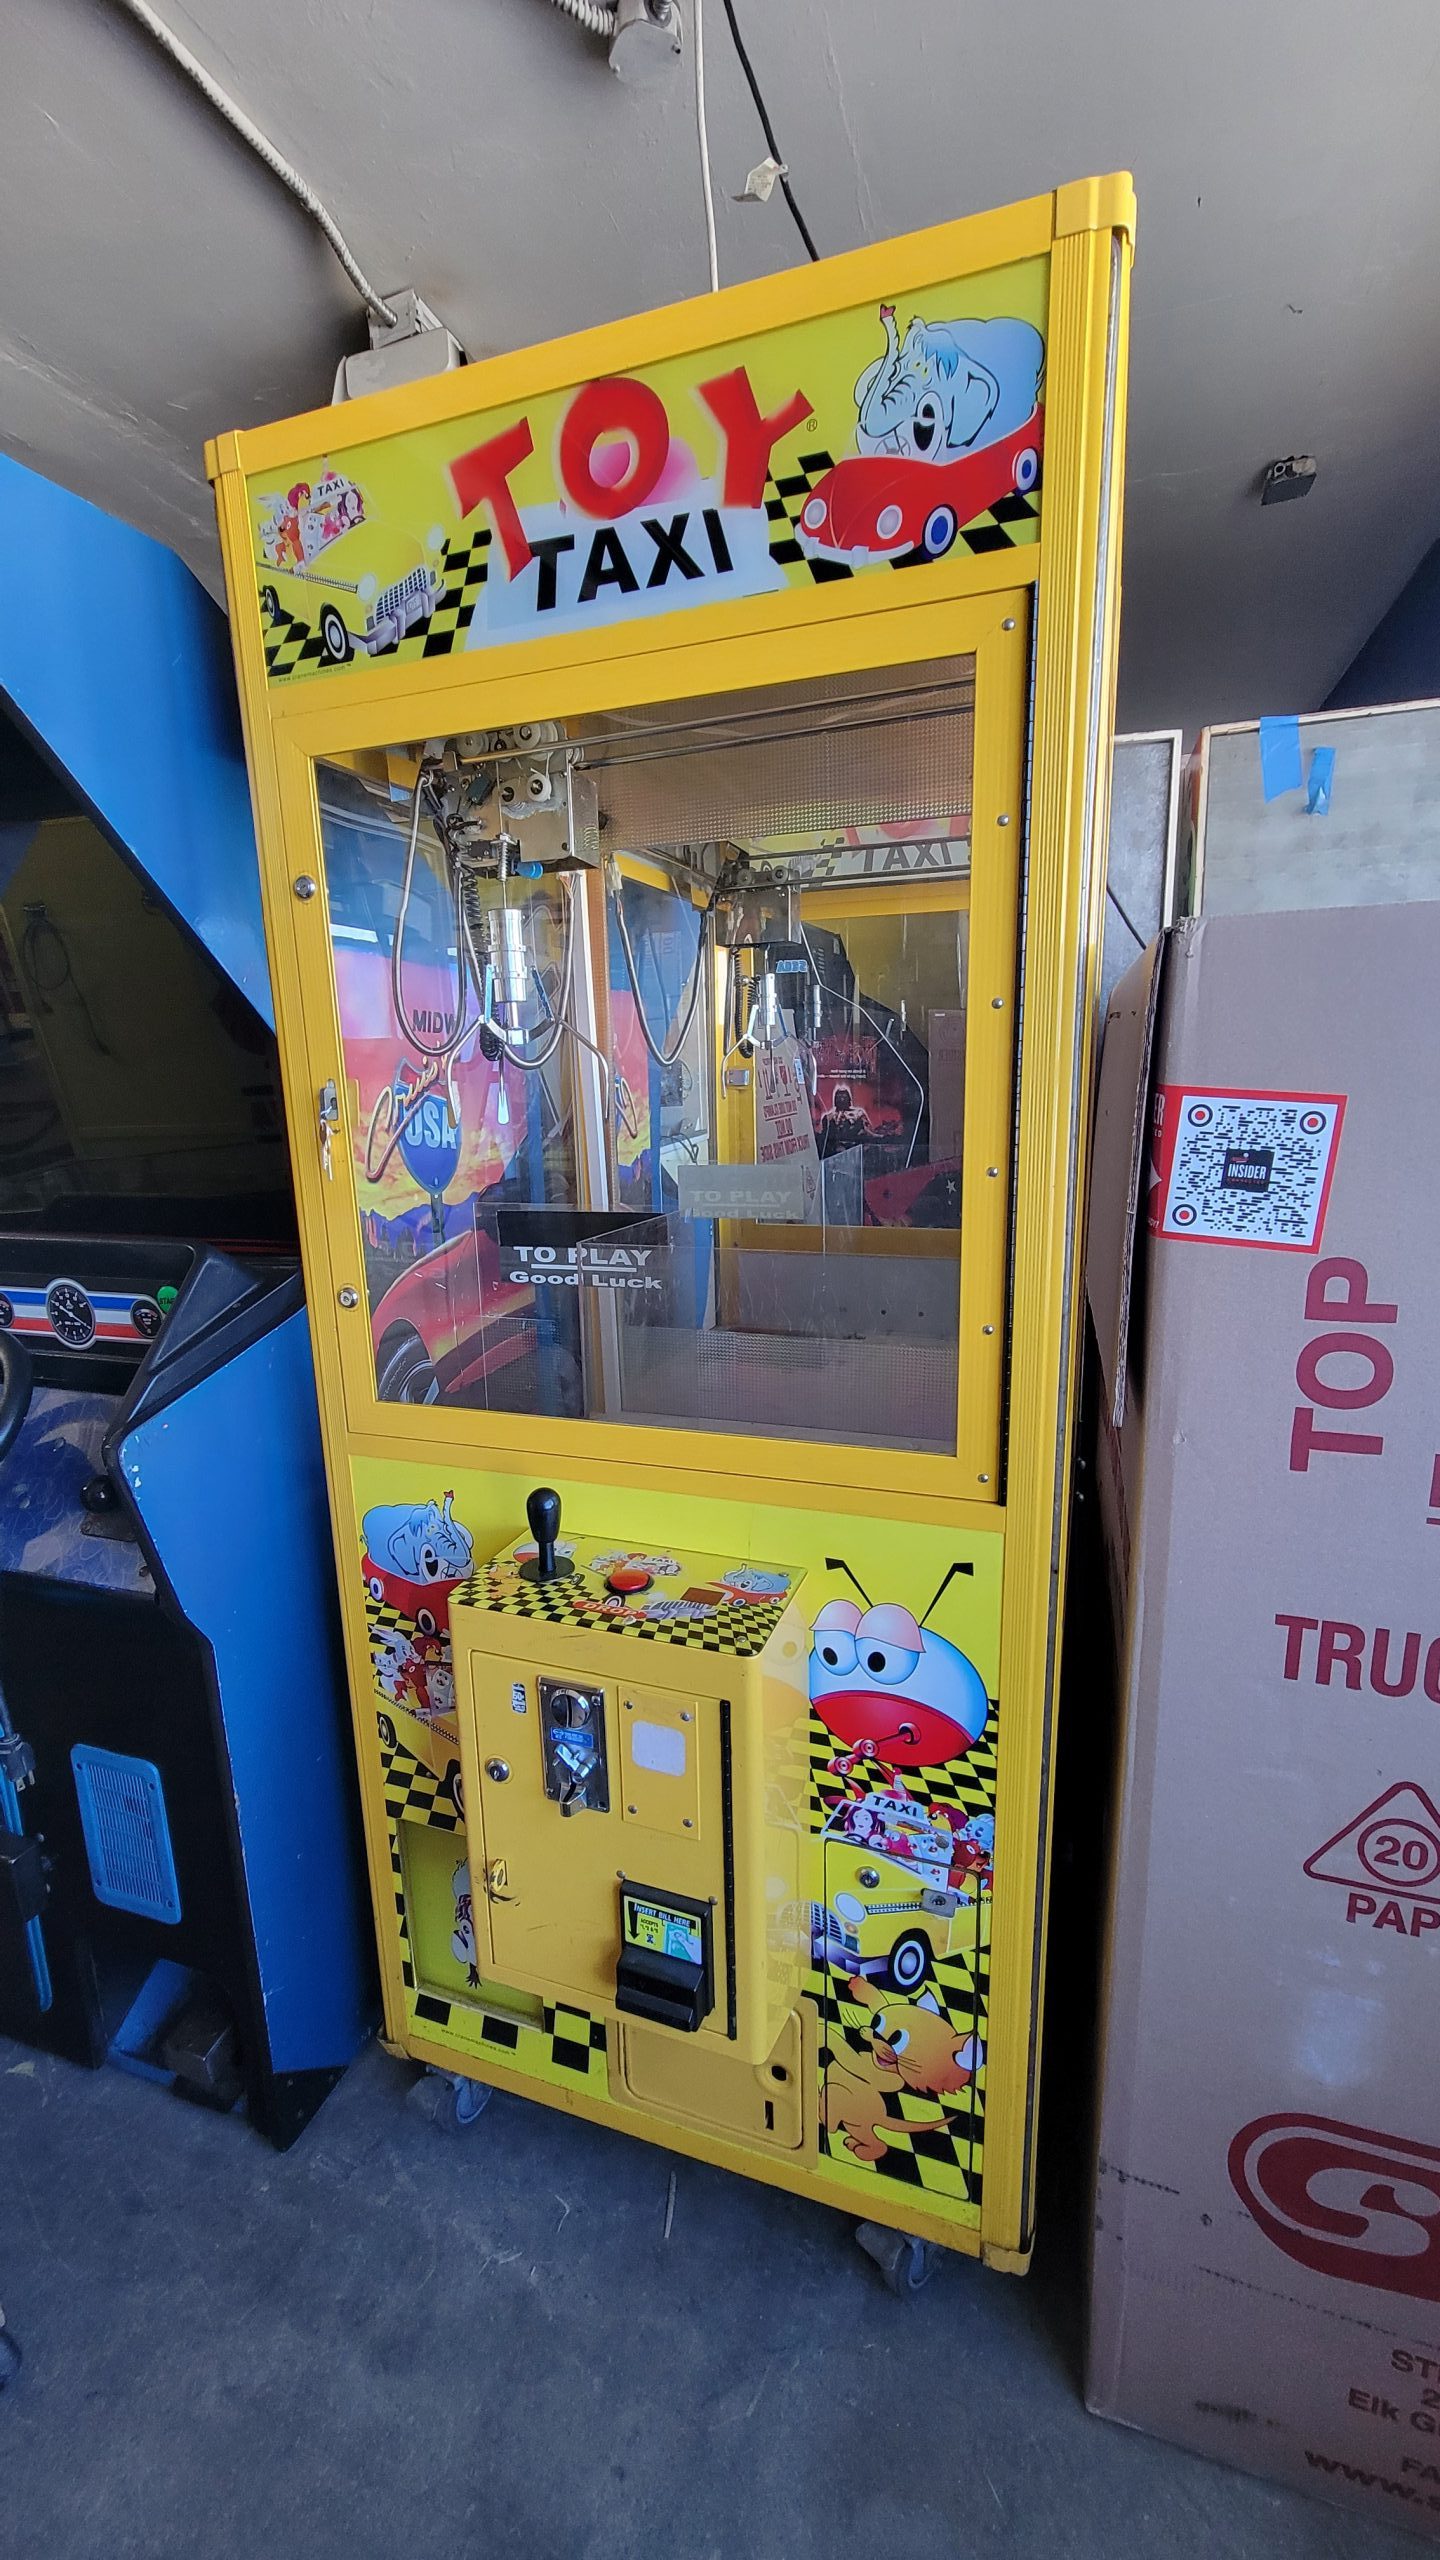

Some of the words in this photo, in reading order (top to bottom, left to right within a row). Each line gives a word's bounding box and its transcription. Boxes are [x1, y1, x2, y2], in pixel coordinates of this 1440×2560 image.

[317, 478, 345, 497] TAXI
[449, 366, 814, 582] TOY
[528, 508, 734, 612] TAXI
[404, 1100, 457, 1150] USA
[1227, 1164, 1267, 1180] INSIDER
[689, 1190, 721, 1202] TO
[730, 1190, 791, 1204] PLAY
[513, 1245, 556, 1263] TO
[568, 1246, 652, 1267] PLAY
[509, 1270, 579, 1286] Good
[592, 1273, 663, 1290] Luck
[1290, 1256, 1399, 1473] TOP
[583, 1601, 637, 1617] DROP
[873, 1795, 917, 1817] TAXI
[1373, 1834, 1429, 1871] 20
[634, 1903, 657, 1917] INSERT
[658, 1911, 672, 1922] BILL
[674, 1916, 691, 1928] HERE
[1346, 1892, 1440, 1938] PAP
[1391, 2349, 1440, 2383] ST
[1349, 2387, 1400, 2422] Elk
[1410, 2411, 1440, 2439] G
